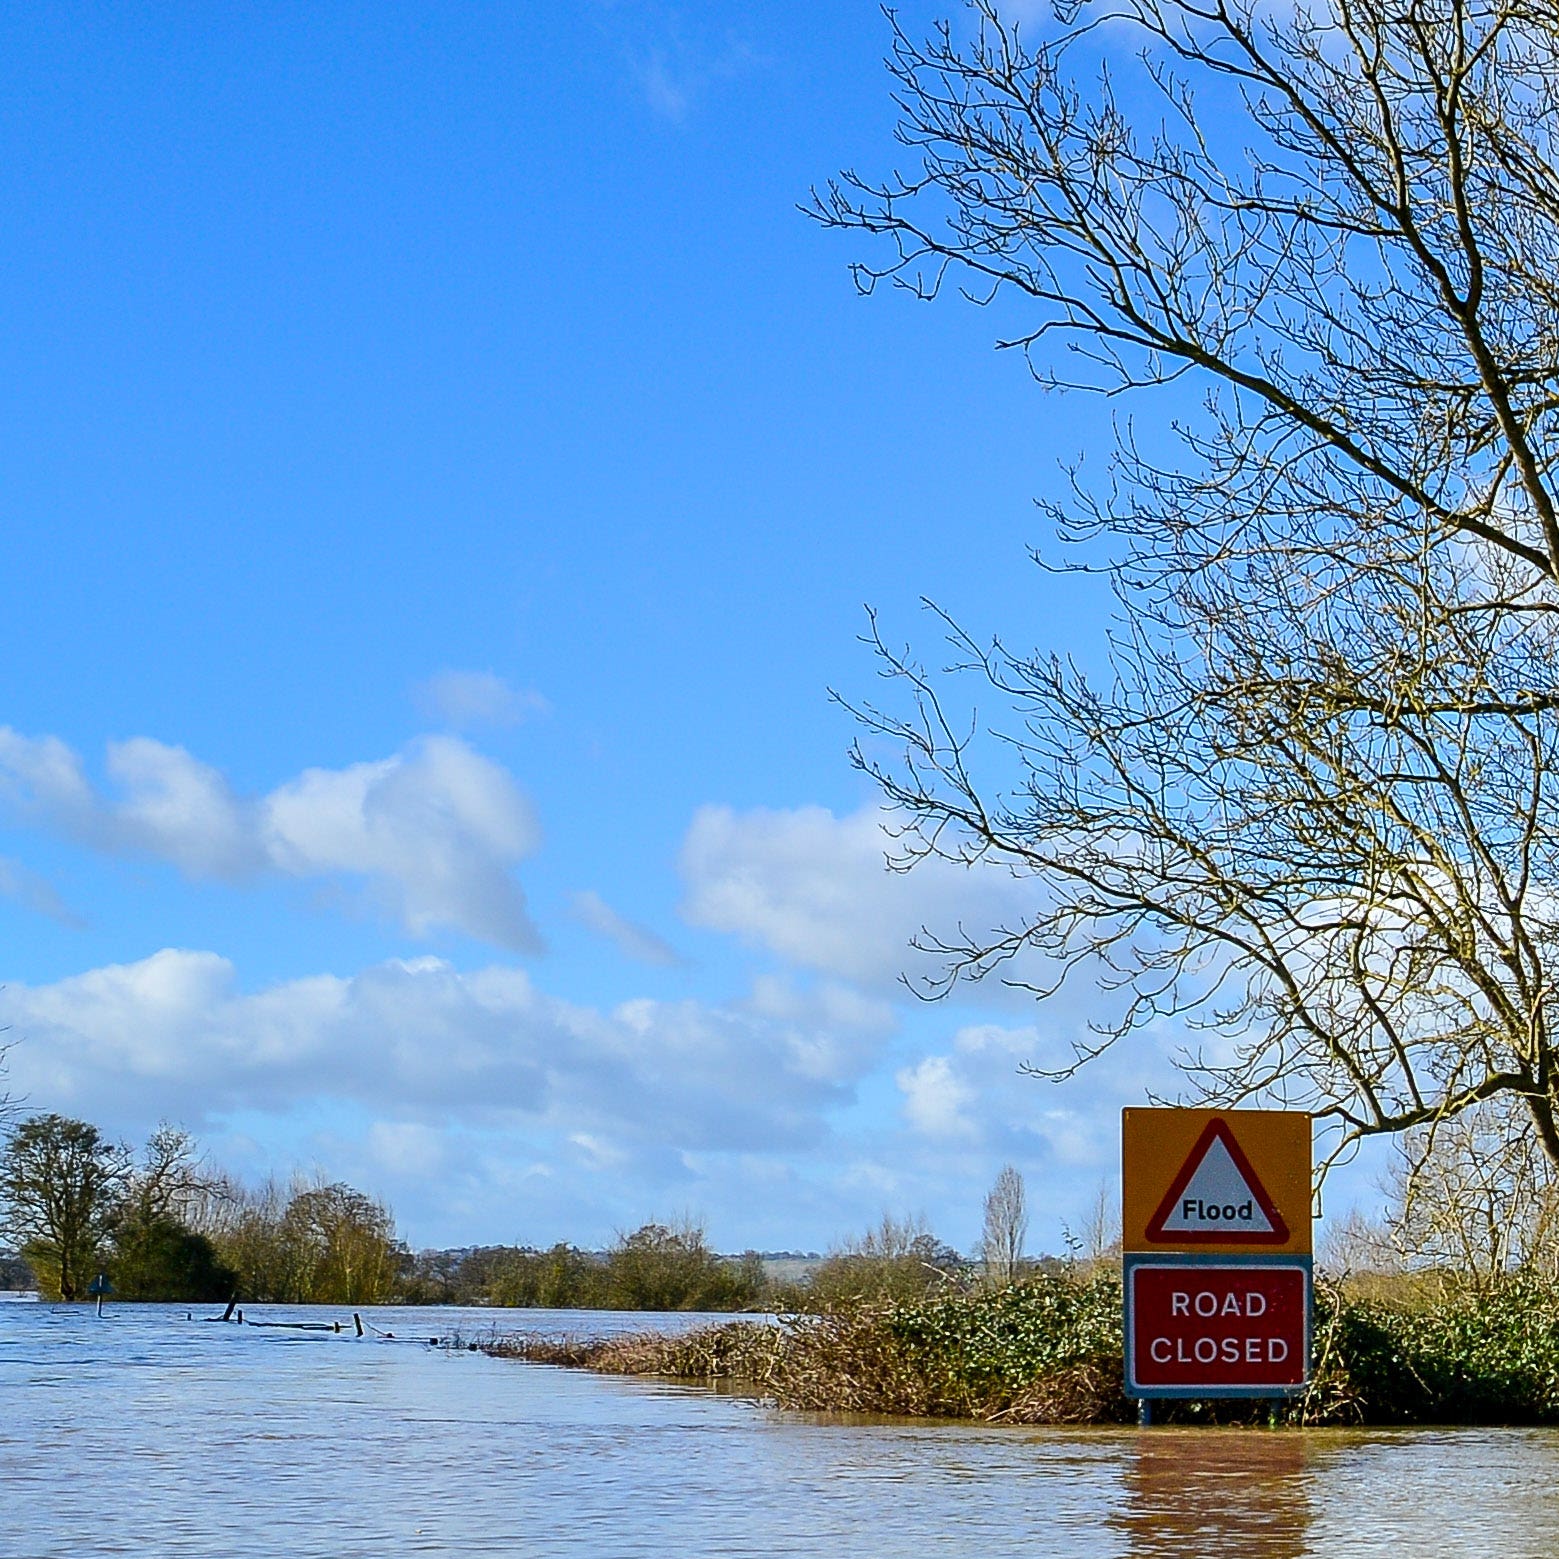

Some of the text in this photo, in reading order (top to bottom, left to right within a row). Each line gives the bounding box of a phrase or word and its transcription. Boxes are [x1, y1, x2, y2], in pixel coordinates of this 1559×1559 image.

[1182, 1199, 1253, 1221] Flood
[1171, 1291, 1267, 1318] ROAD
[1150, 1337, 1289, 1364] CLOSED
